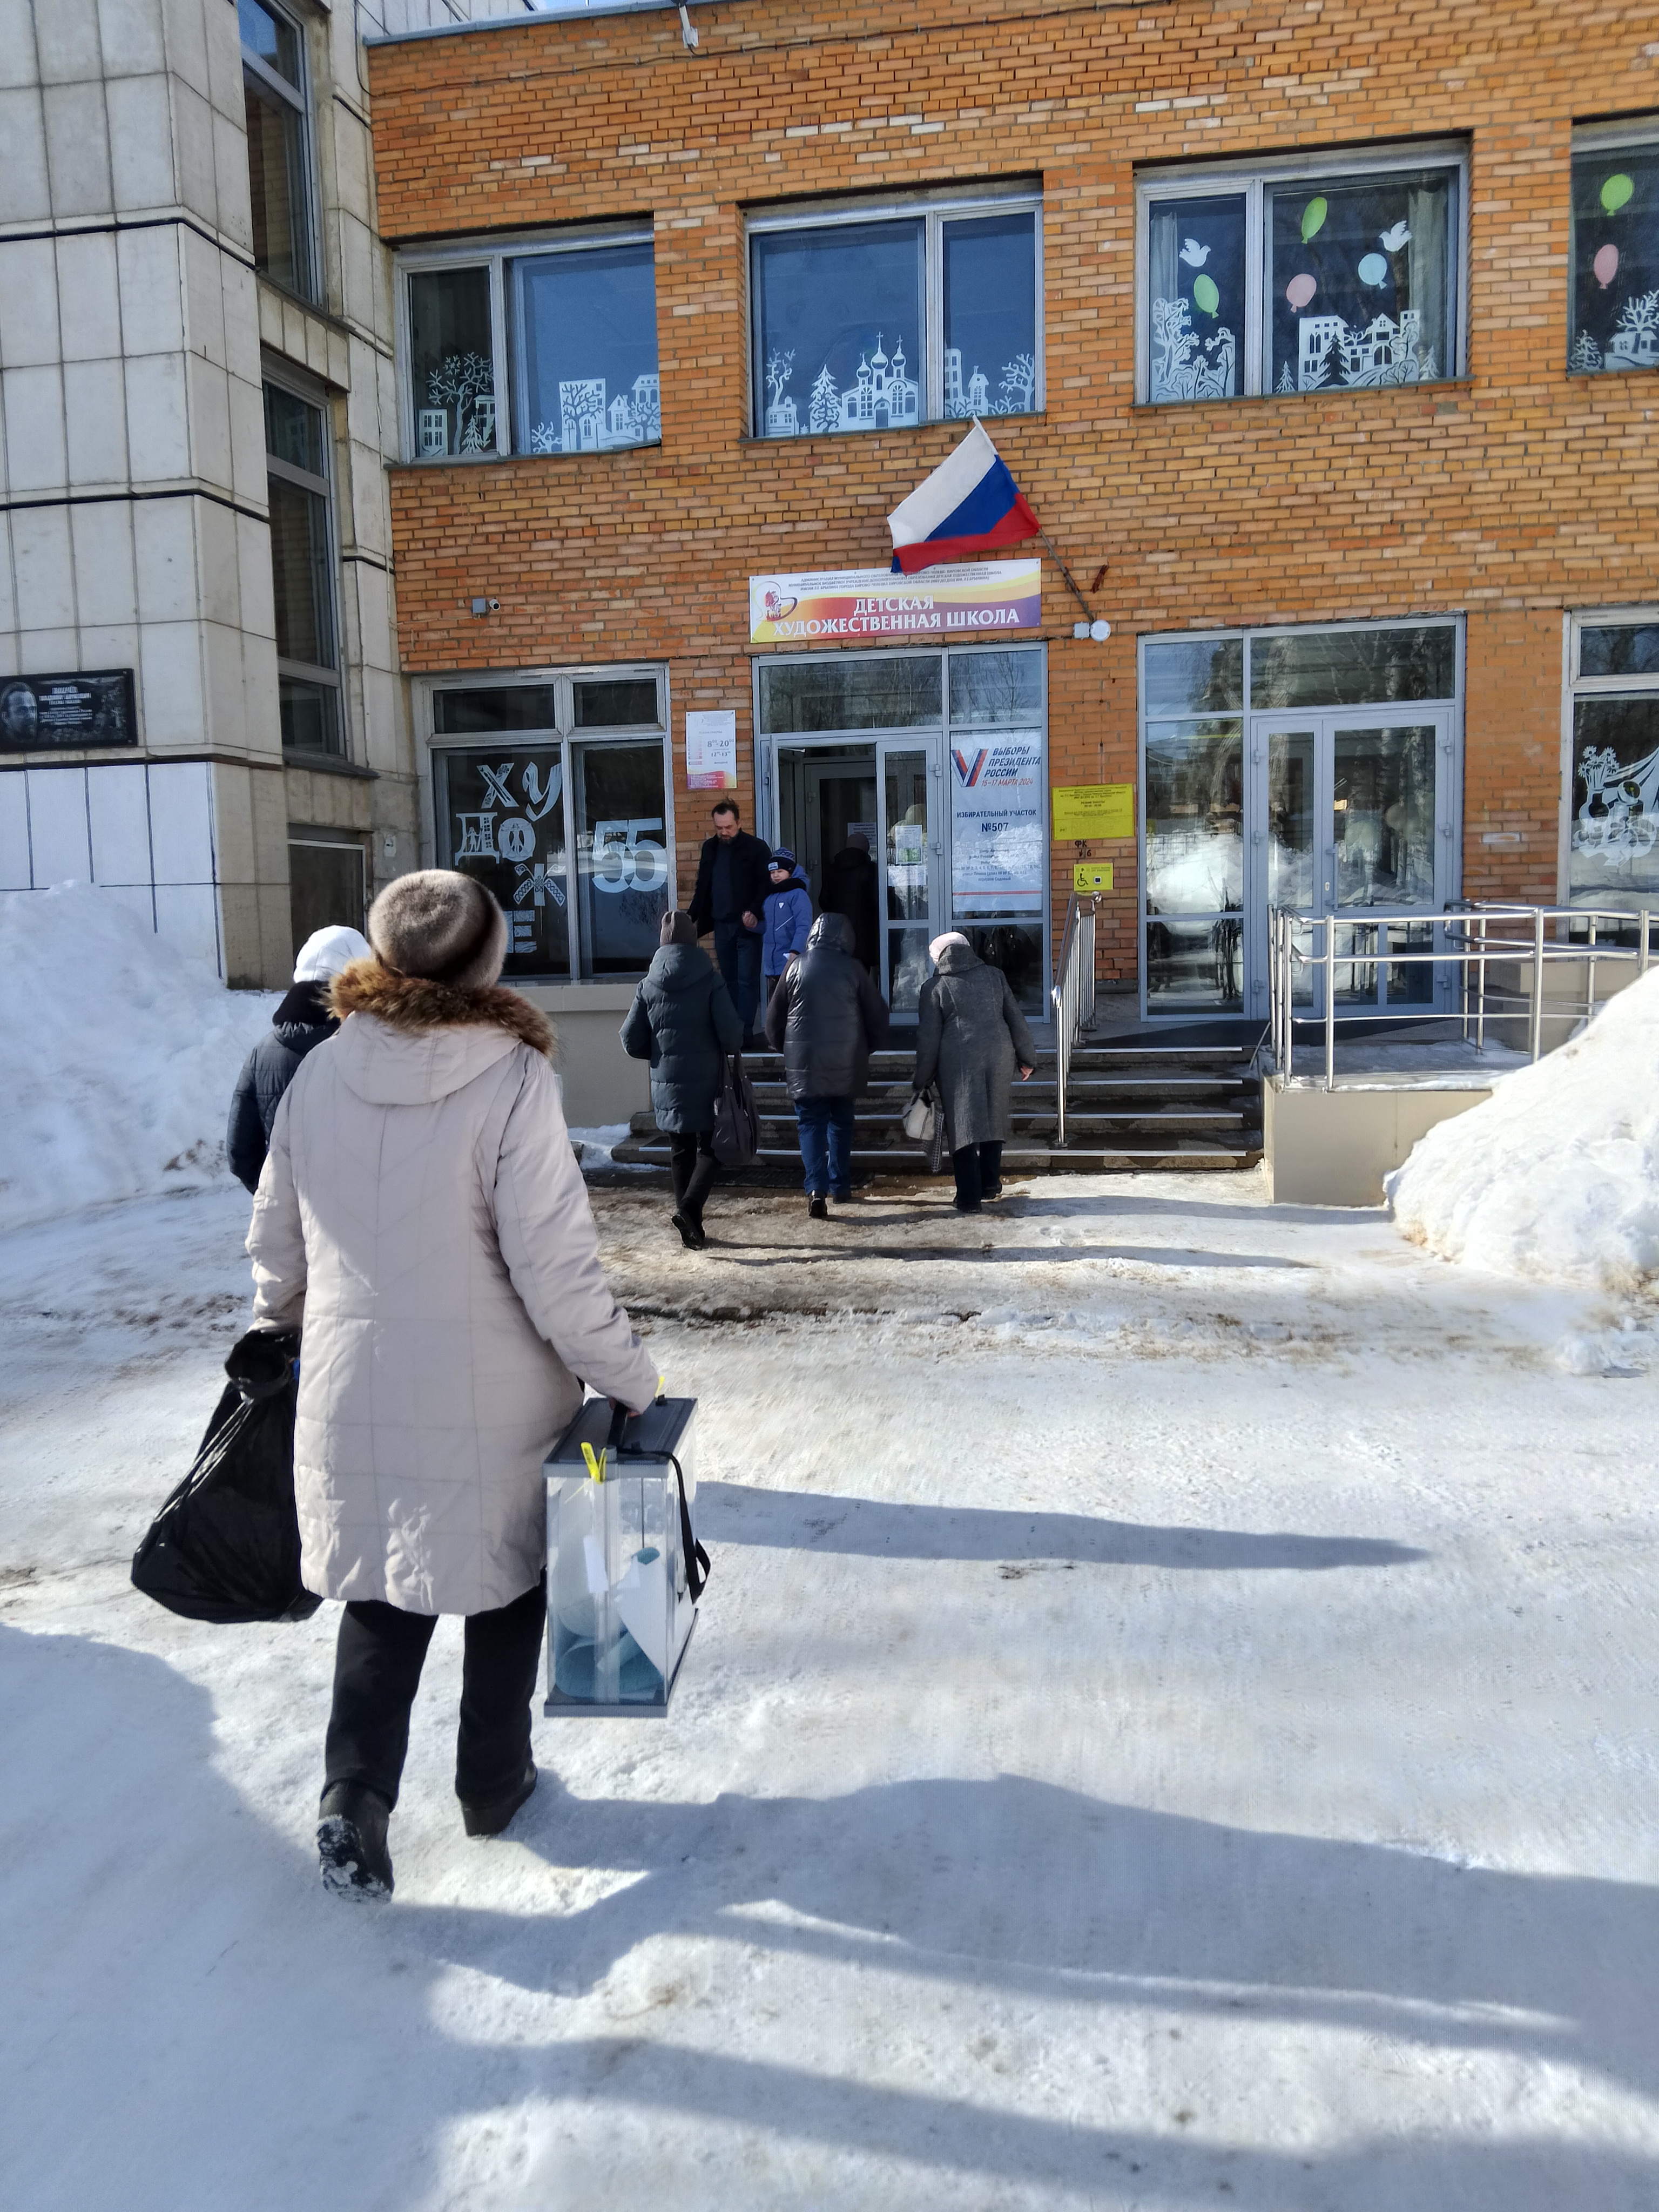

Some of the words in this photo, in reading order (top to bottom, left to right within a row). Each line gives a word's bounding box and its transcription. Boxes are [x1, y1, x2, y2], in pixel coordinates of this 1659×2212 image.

[854, 595, 934, 616] ДЕТСКАЯ
[773, 612, 941, 638] ХУДОЖЕСТВЕННАЯ
[947, 608, 1020, 627] ШКОЛА
[993, 746, 1030, 756] ВЫБОРЫ
[988, 757, 1041, 767] ПРЕЗИДЕНТА
[984, 768, 1019, 778] РОССИИ
[998, 778, 1018, 786] МАРТА
[957, 810, 1008, 818] ИЗБИРАТЕЛЬНЫЙ
[981, 822, 1009, 832] №507
[592, 818, 667, 893] 55
